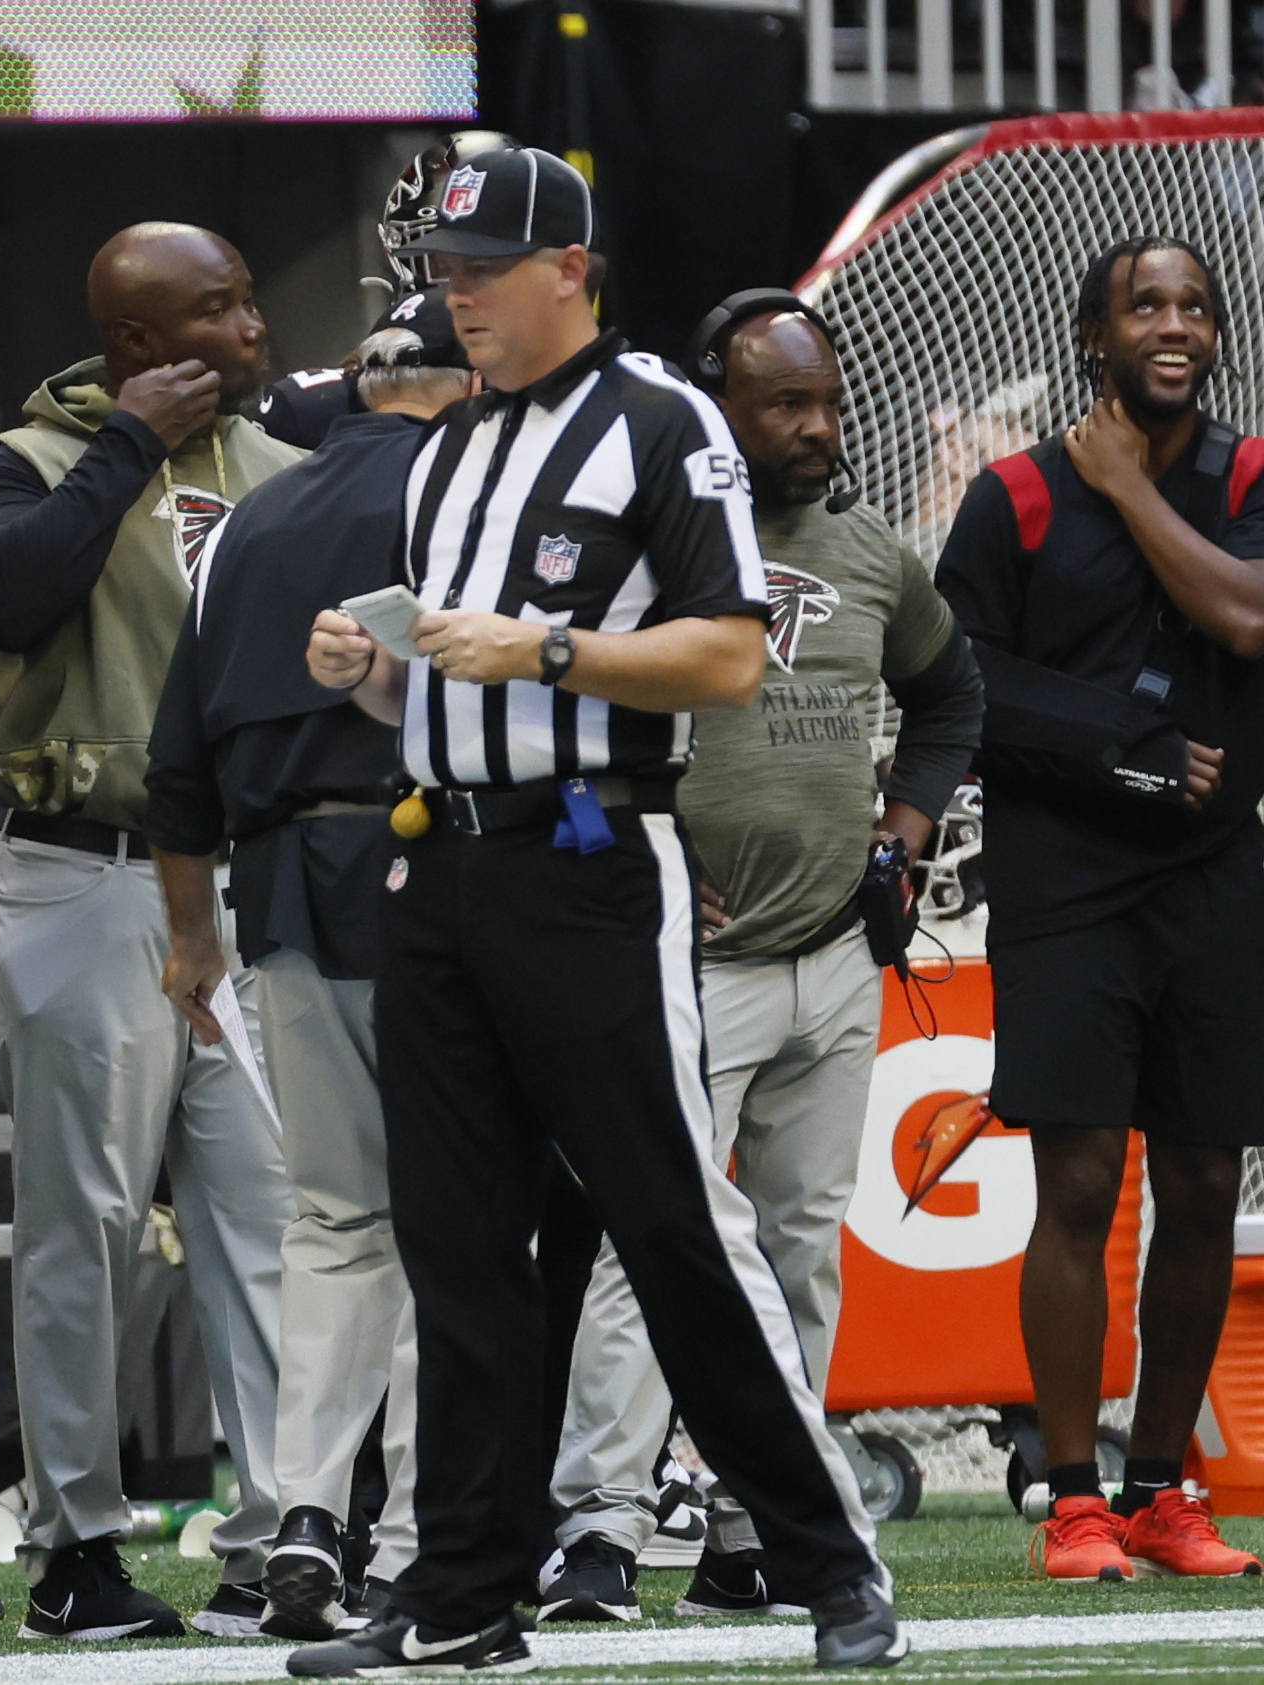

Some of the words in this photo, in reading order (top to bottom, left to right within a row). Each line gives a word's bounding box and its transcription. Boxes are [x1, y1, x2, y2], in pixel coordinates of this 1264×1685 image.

[539, 553, 570, 576] NFL
[761, 684, 854, 714] ATLANTA
[768, 715, 859, 746] FALCONS
[892, 1089, 1032, 1217] G
